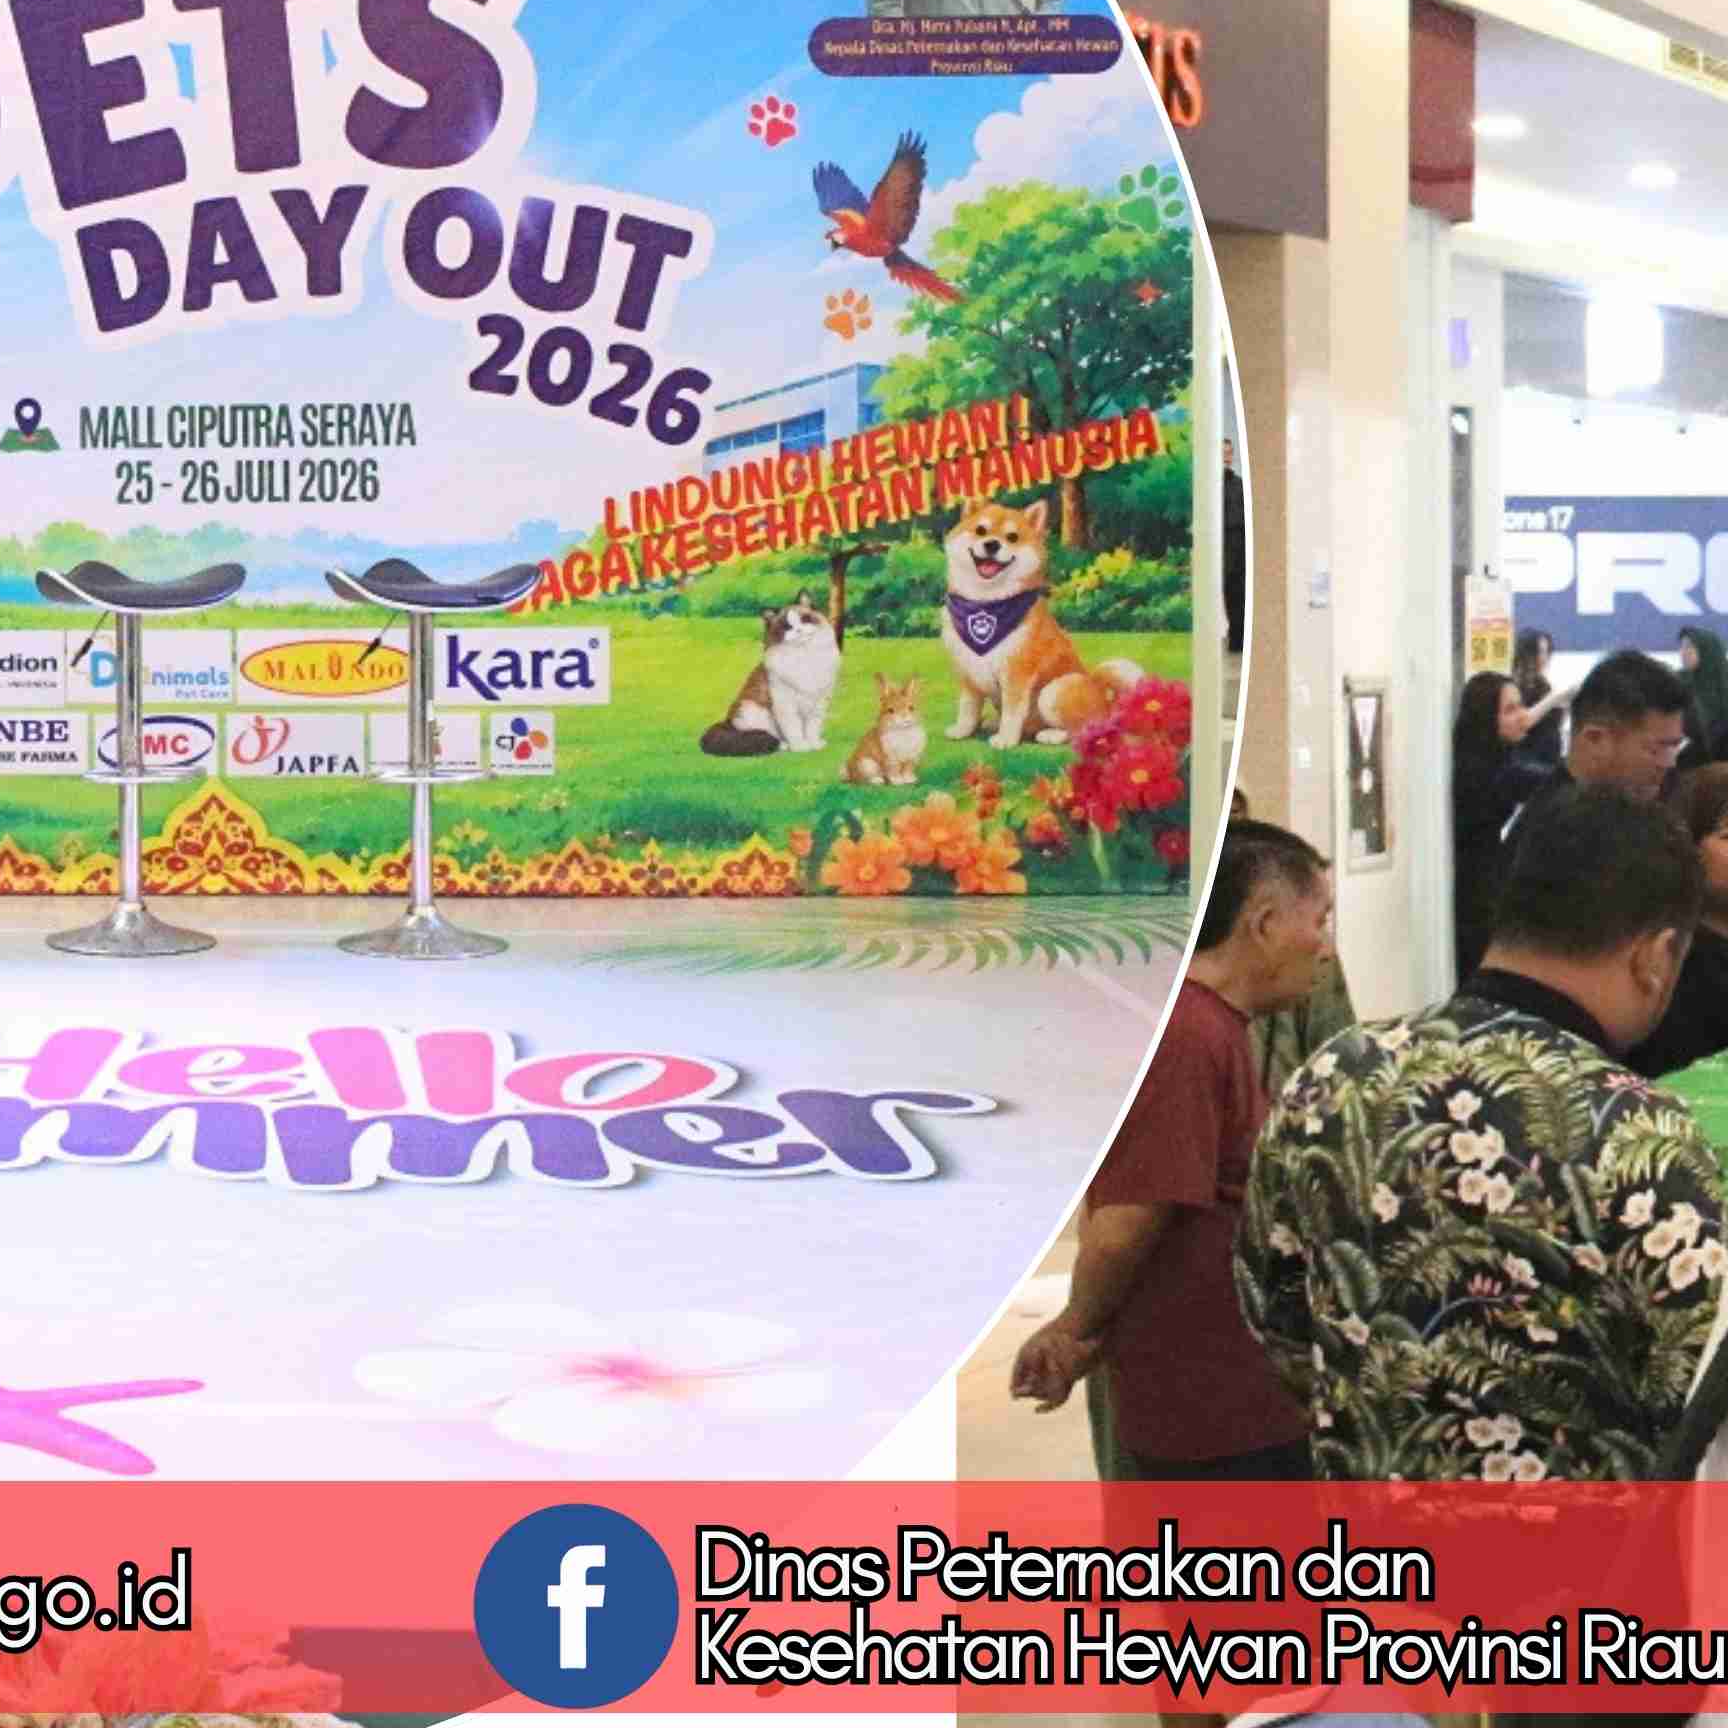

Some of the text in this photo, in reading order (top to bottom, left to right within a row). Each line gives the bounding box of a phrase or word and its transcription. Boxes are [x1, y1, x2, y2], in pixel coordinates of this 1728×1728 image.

[77, 184, 694, 333] DAY OUT
[469, 314, 713, 446] 2026
[79, 402, 417, 450] MALL CIPUTRA SERAYA
[115, 460, 154, 504] 25
[180, 460, 223, 503] 26
[225, 458, 292, 503] JULI
[298, 458, 381, 503] 2026
[603, 450, 824, 544] LINDUNGI
[825, 398, 1010, 478] HEWAN
[643, 468, 934, 578] KESEHATAN
[935, 407, 1164, 510] MANUSIA
[149, 666, 230, 686] nimals
[445, 634, 596, 702] kara
[20, 752, 79, 763] FARMA
[143, 734, 190, 755] MC
[273, 754, 359, 776] JAPFA
